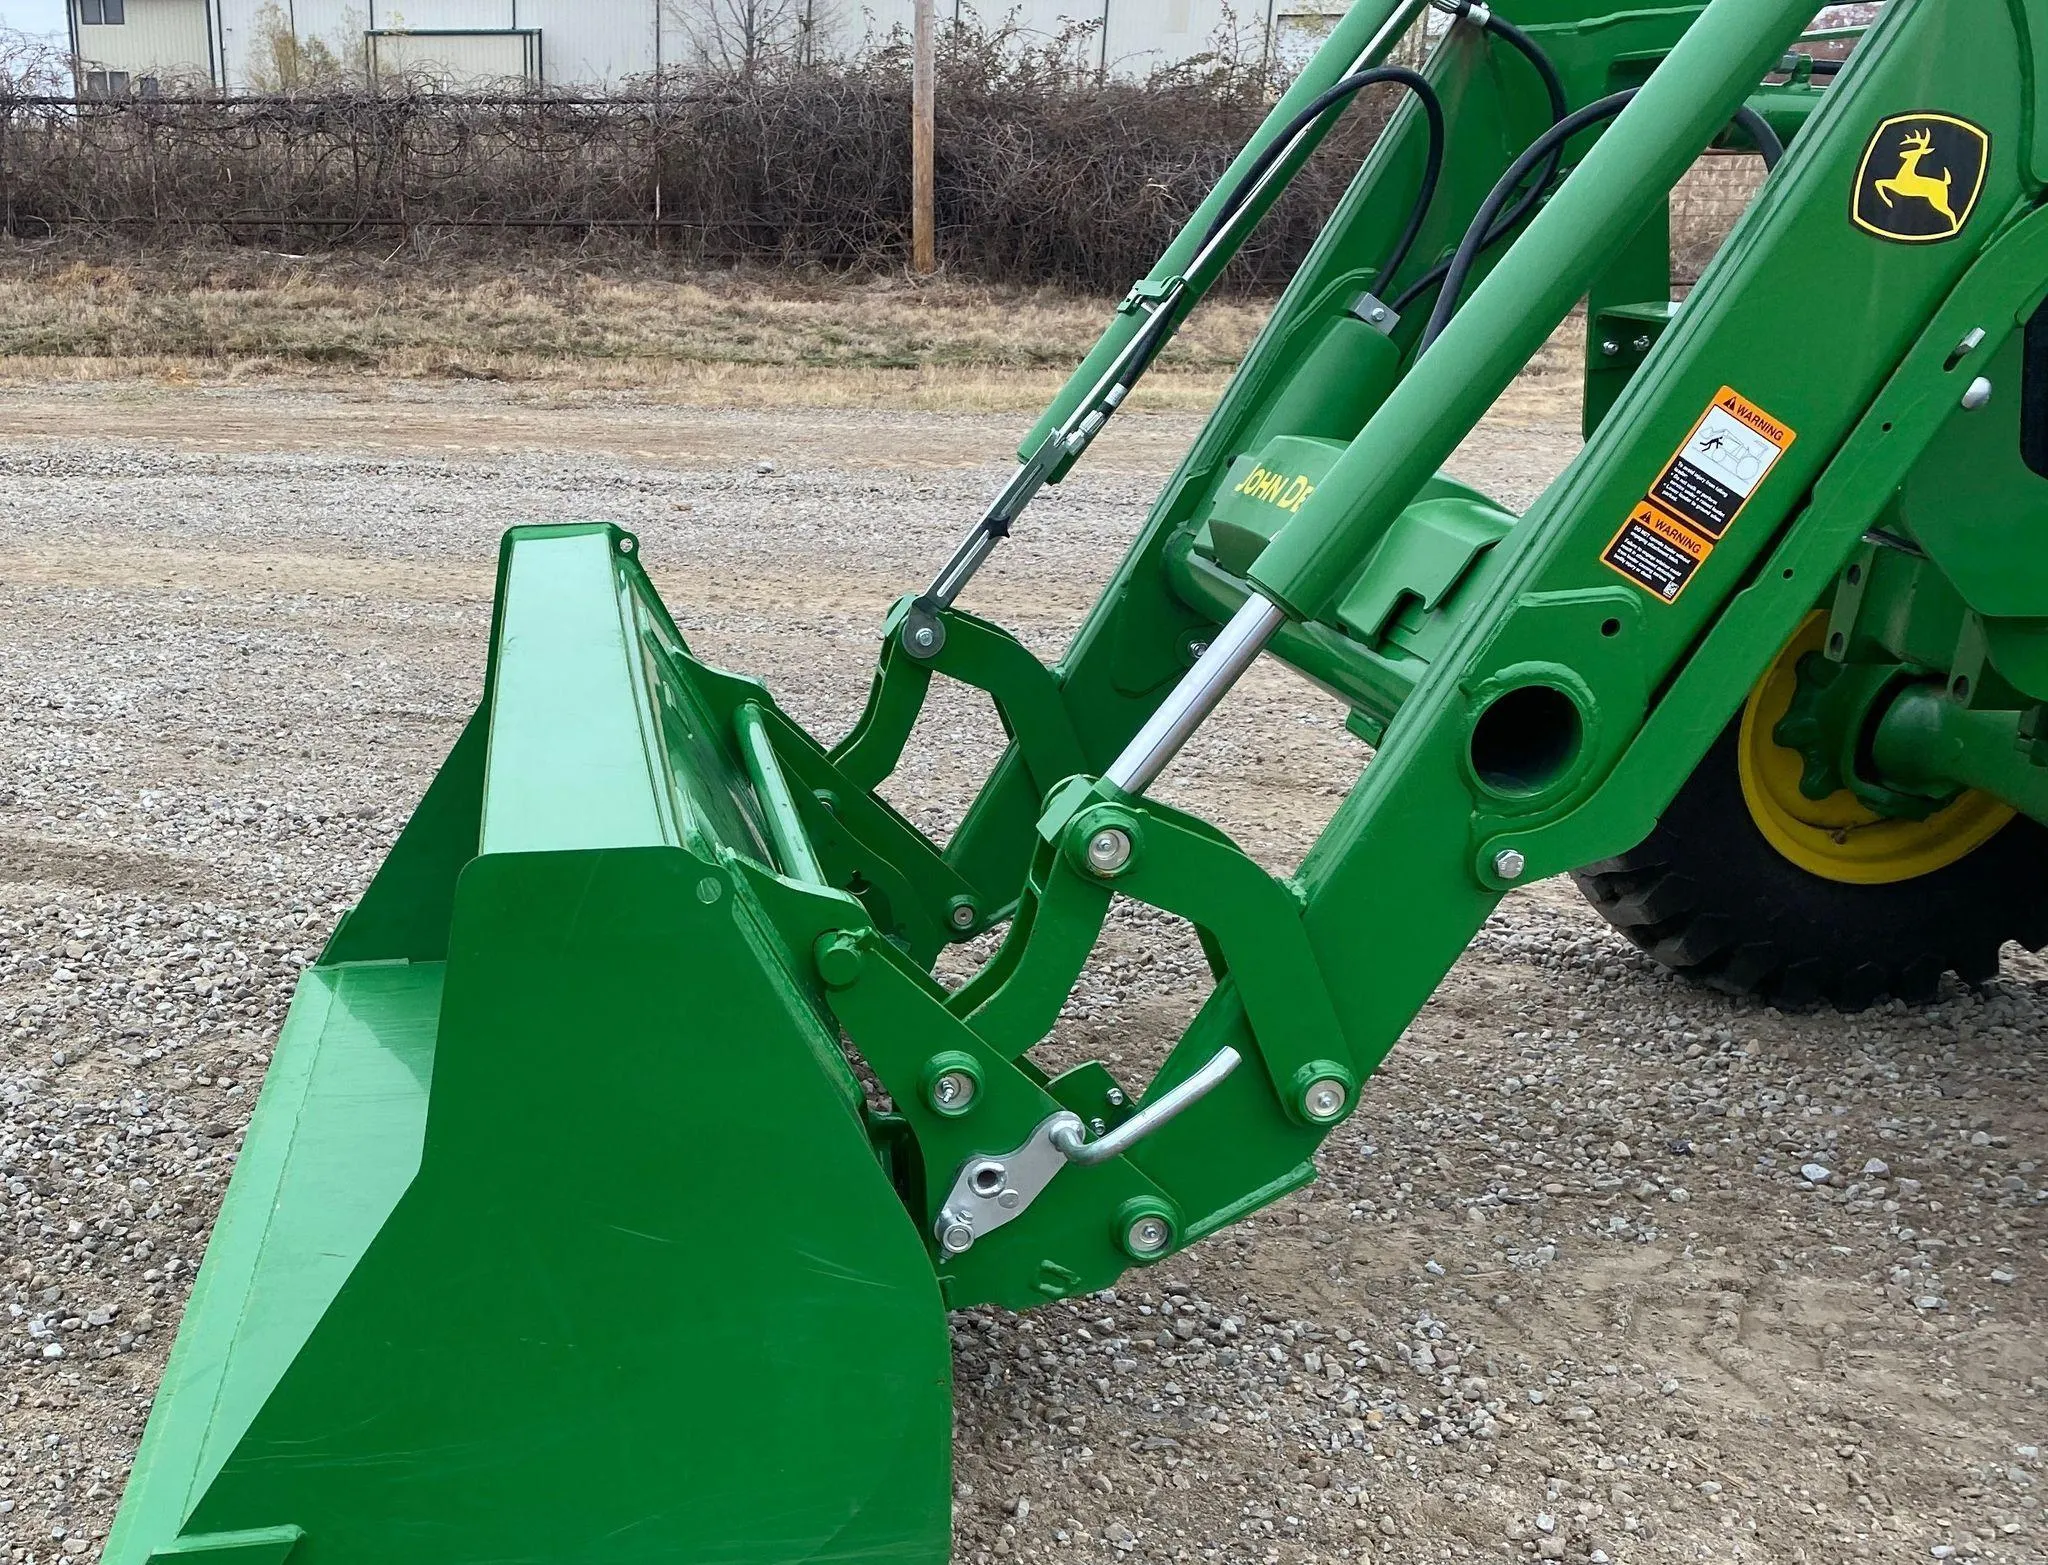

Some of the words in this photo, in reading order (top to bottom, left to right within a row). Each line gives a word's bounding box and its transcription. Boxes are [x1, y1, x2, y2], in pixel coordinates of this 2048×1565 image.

[1737, 405, 1784, 441] WARNING
[1234, 462, 1290, 503] JOHN
[1655, 518, 1702, 554] WARNING
